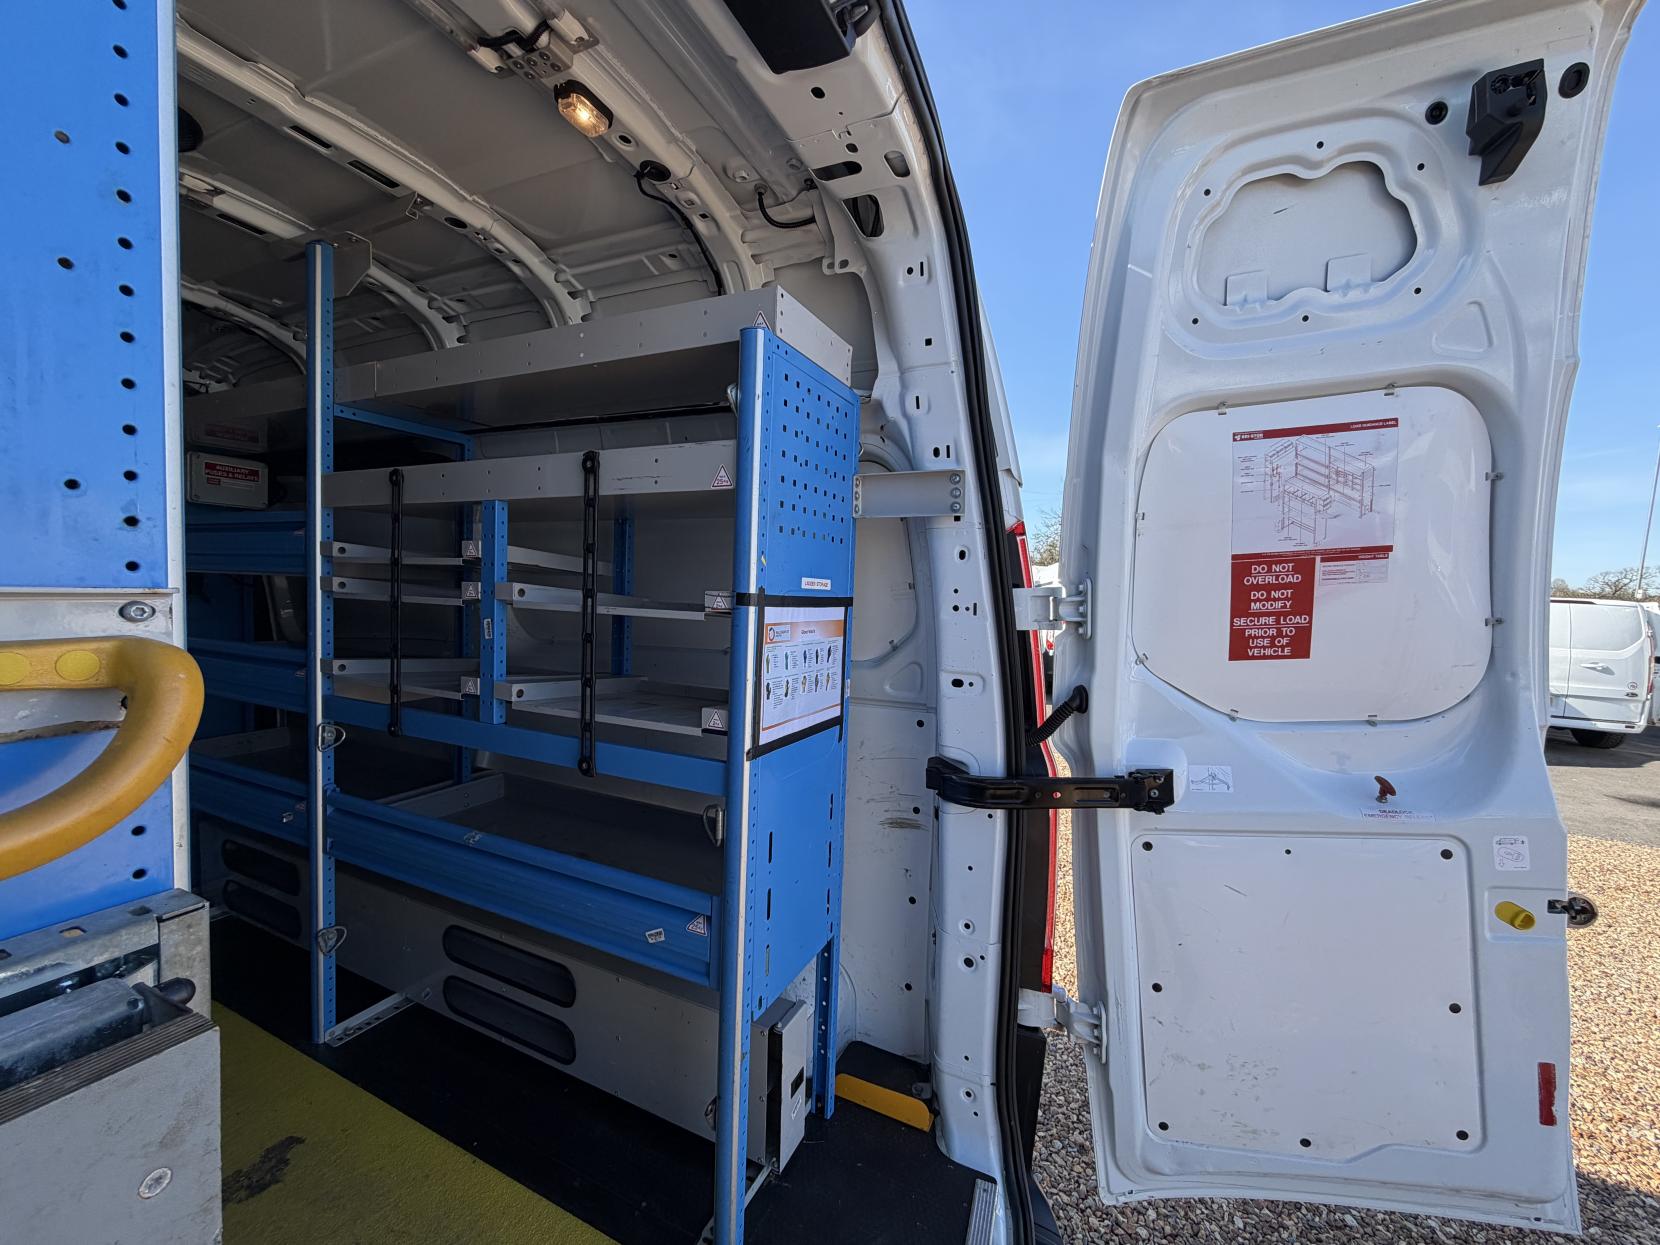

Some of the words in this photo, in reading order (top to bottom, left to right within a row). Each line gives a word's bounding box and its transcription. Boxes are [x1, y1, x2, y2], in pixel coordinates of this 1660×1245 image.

[1251, 565, 1268, 574] DO
[1272, 563, 1294, 572] NOT
[1243, 574, 1302, 585] OVERLOAD
[1250, 591, 1267, 600] DO
[1271, 589, 1294, 599] NOT
[1250, 600, 1292, 611] MODIFY
[1233, 616, 1276, 626] SECURE
[1280, 615, 1309, 625] LOAD
[1245, 628, 1277, 637] PRIOR
[1281, 627, 1295, 636] TO
[1249, 638, 1271, 647] USE
[1275, 637, 1290, 646] OF
[1247, 647, 1291, 657] VEHICLE
